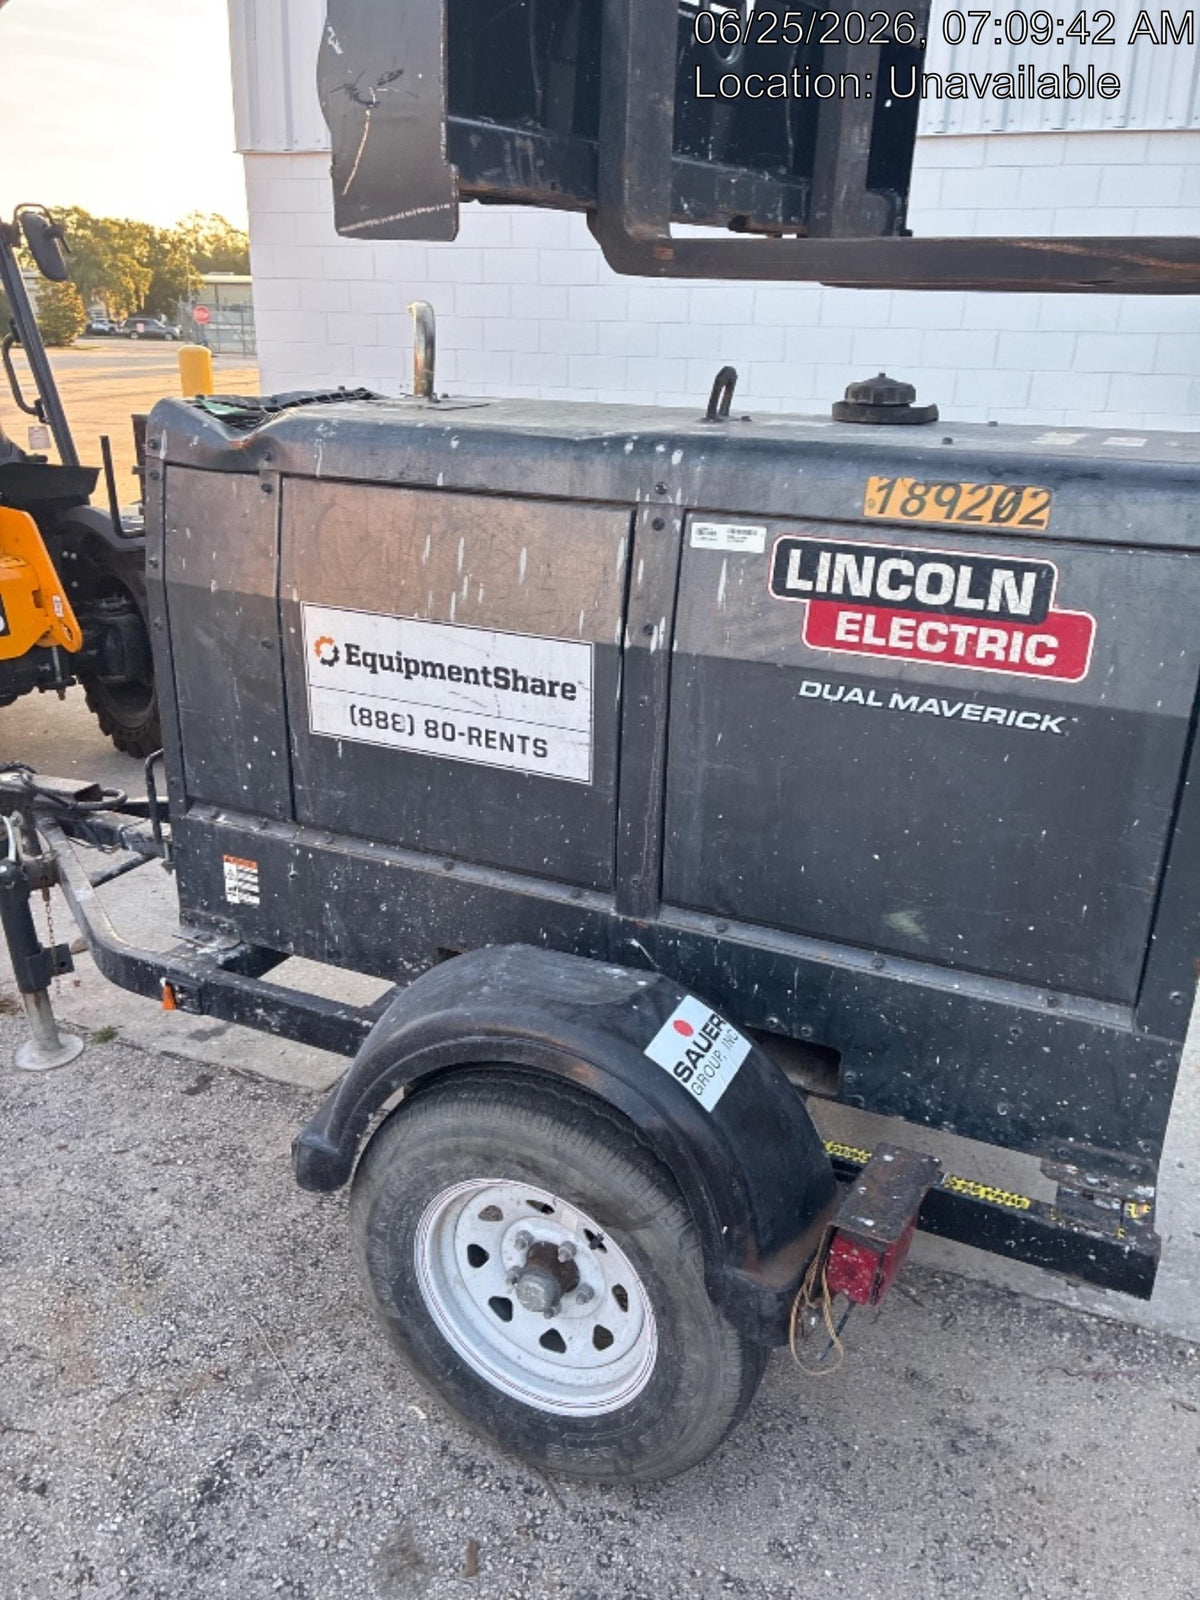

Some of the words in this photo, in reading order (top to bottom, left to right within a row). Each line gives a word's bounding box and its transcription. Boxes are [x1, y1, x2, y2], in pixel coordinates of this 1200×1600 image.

[876, 477, 1051, 525] 189202
[786, 548, 1037, 616] LINCOLN
[835, 611, 1059, 667] ELECTRIC
[344, 643, 577, 701] EquipmentShare
[798, 680, 883, 707] DUAL
[888, 693, 1067, 733] MAVERICK
[424, 719, 548, 758] 80-RENTS
[673, 1013, 727, 1084] SAUER
